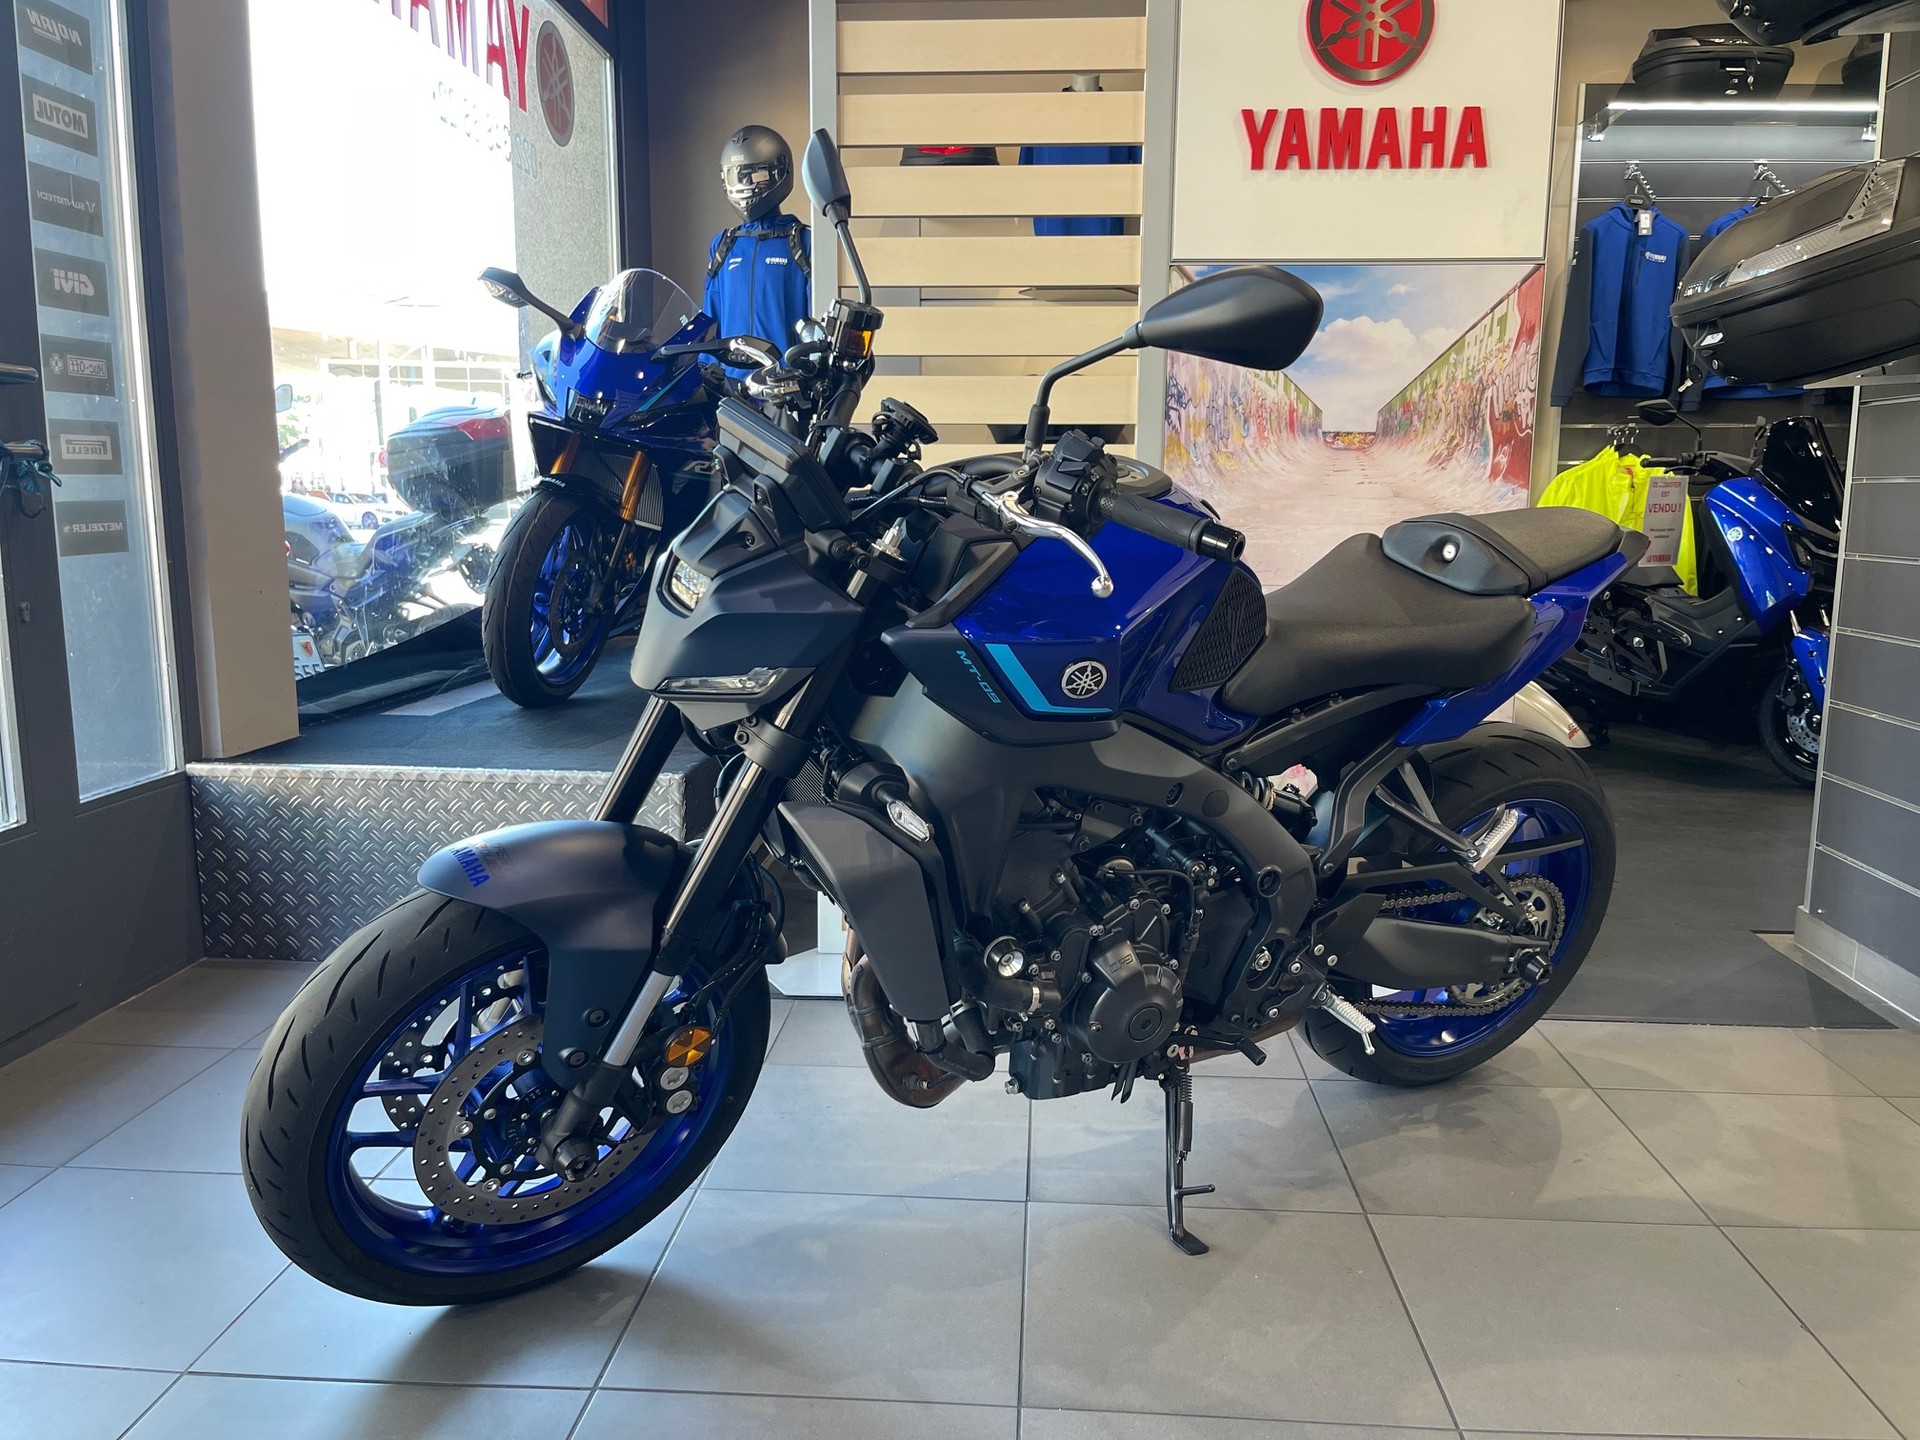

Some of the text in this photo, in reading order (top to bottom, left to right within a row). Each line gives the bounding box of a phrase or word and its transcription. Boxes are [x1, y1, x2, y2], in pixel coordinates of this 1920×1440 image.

[1241, 106, 1488, 170] YAMAHA
[1648, 503, 1677, 514] VENDU
[955, 650, 1001, 704] MT-09
[449, 847, 490, 888] AMAHA
